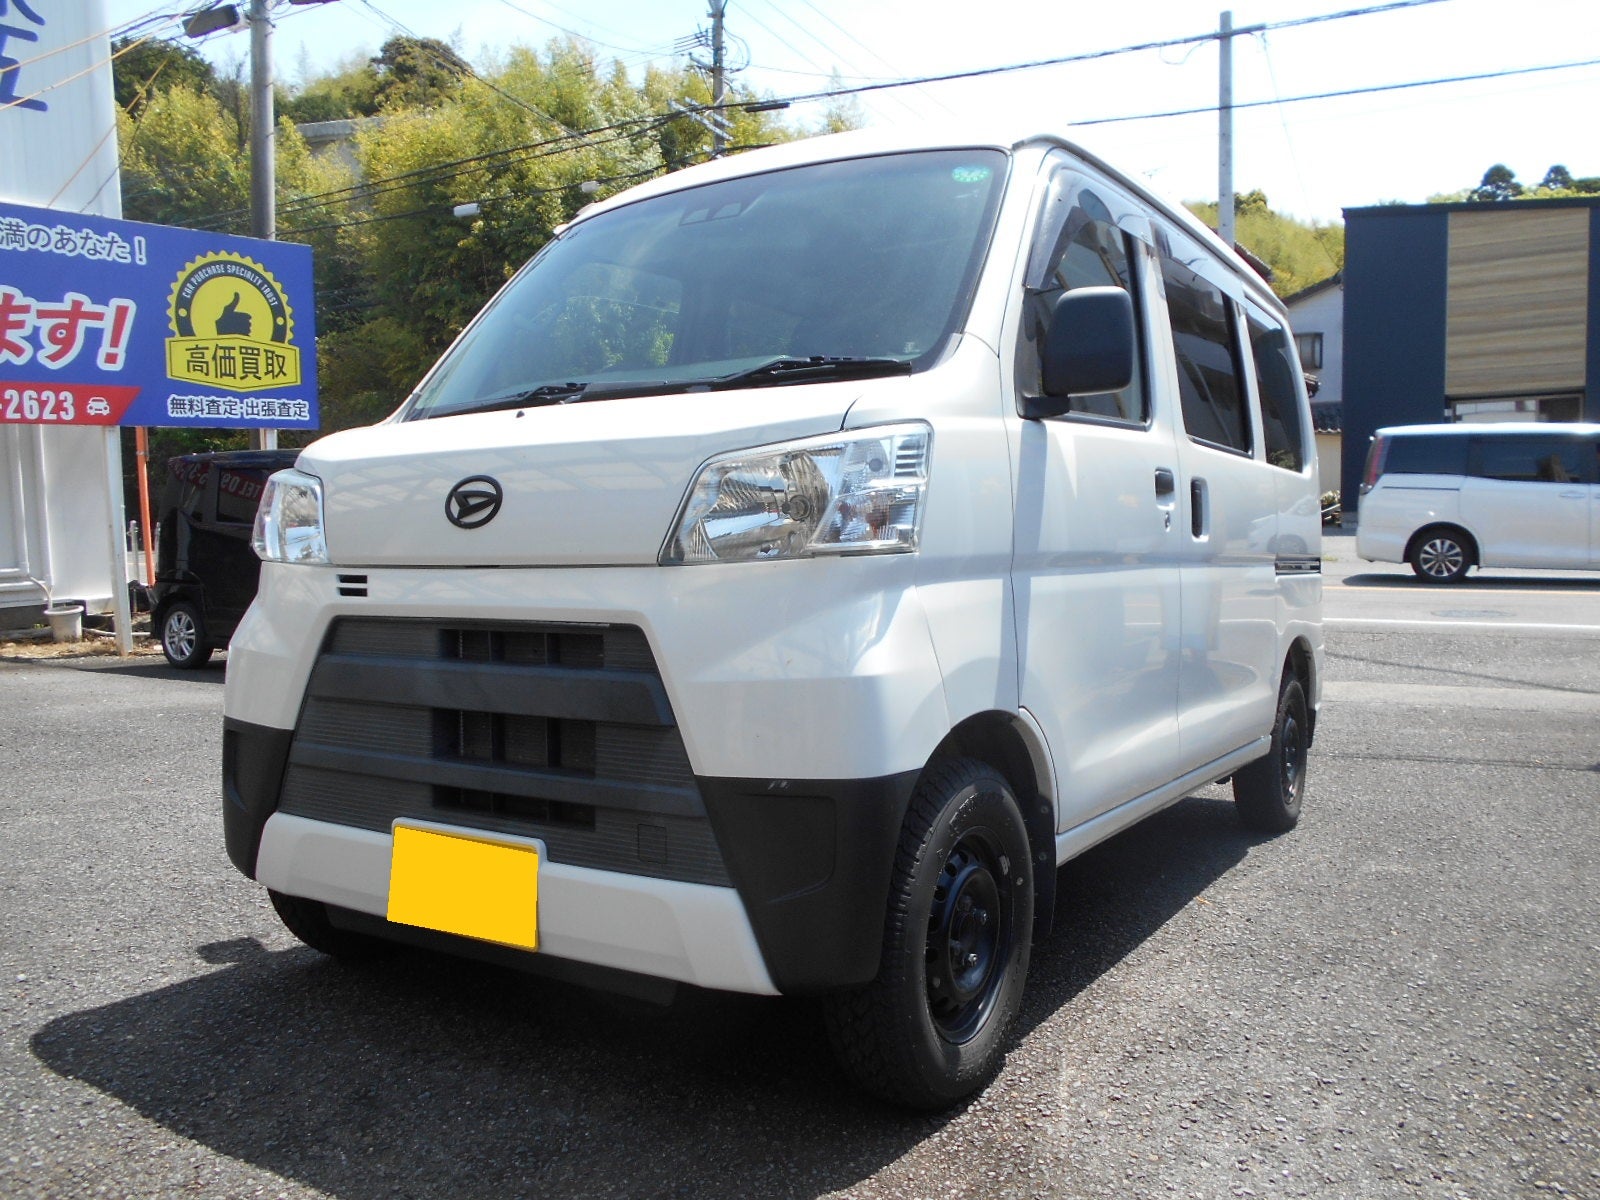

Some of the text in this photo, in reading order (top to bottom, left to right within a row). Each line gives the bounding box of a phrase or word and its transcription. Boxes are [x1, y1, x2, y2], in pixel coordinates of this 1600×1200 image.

[183, 264, 279, 306] CAR PURCHASE SPECIALTY TRUST
[185, 343, 287, 380] 高価買取
